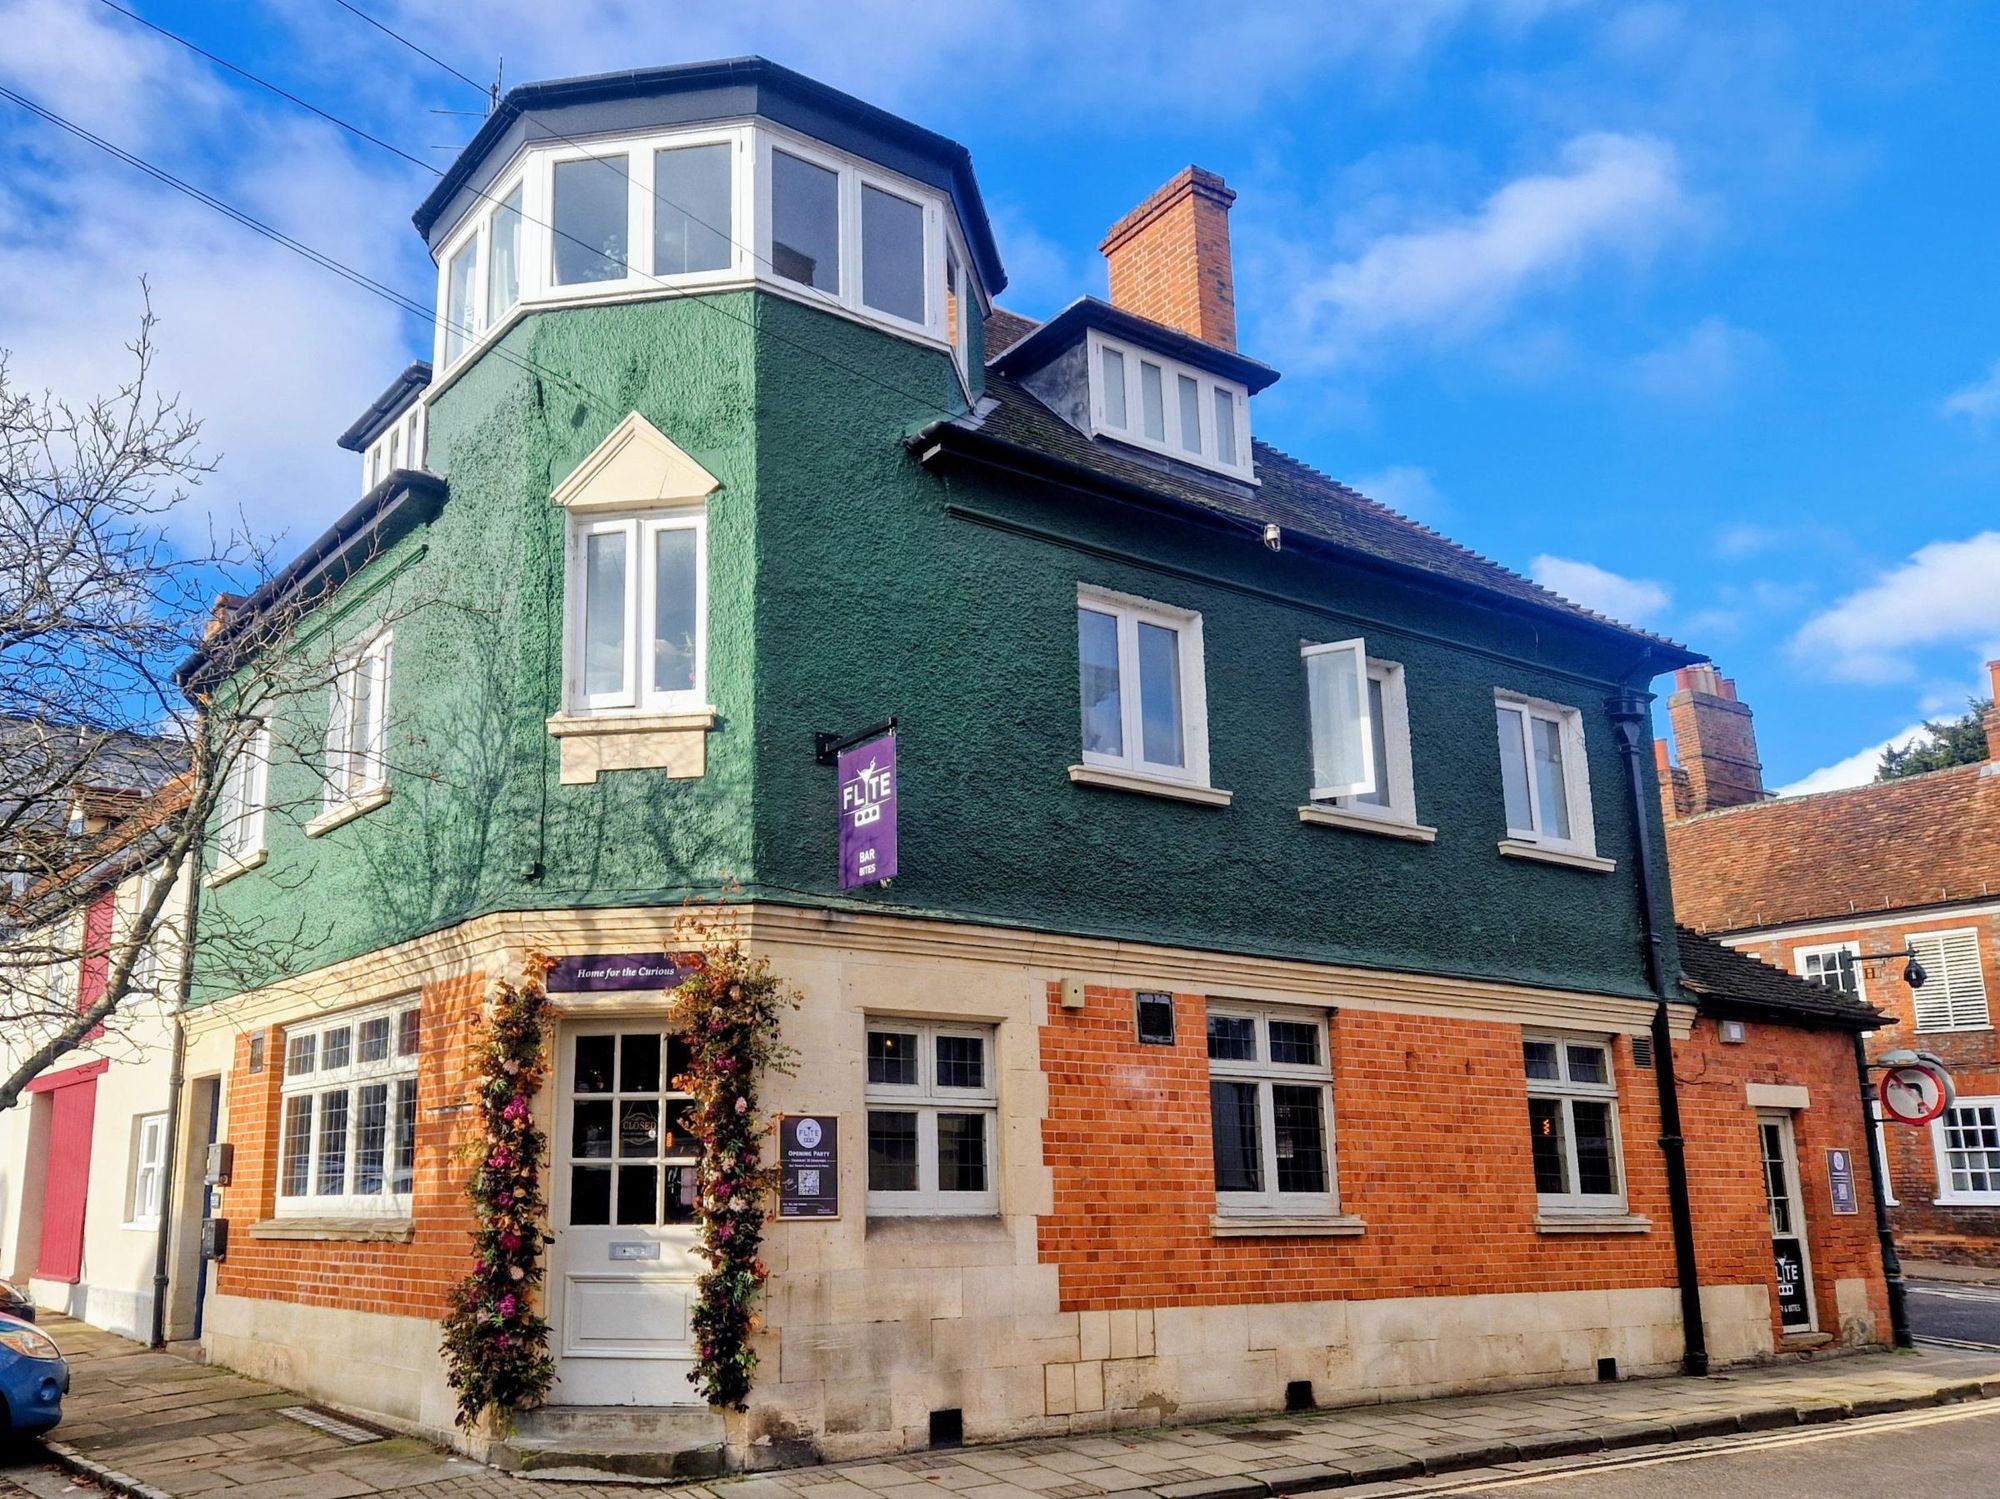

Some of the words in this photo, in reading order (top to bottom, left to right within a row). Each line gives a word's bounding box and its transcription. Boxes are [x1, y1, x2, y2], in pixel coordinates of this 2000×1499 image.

[859, 848, 875, 863] BAR
[859, 863, 876, 877] BITES
[577, 969, 604, 978] Home
[604, 967, 620, 980] for
[622, 967, 636, 977] the
[638, 966, 675, 976] Curious
[622, 1120, 656, 1131] CLOSED
